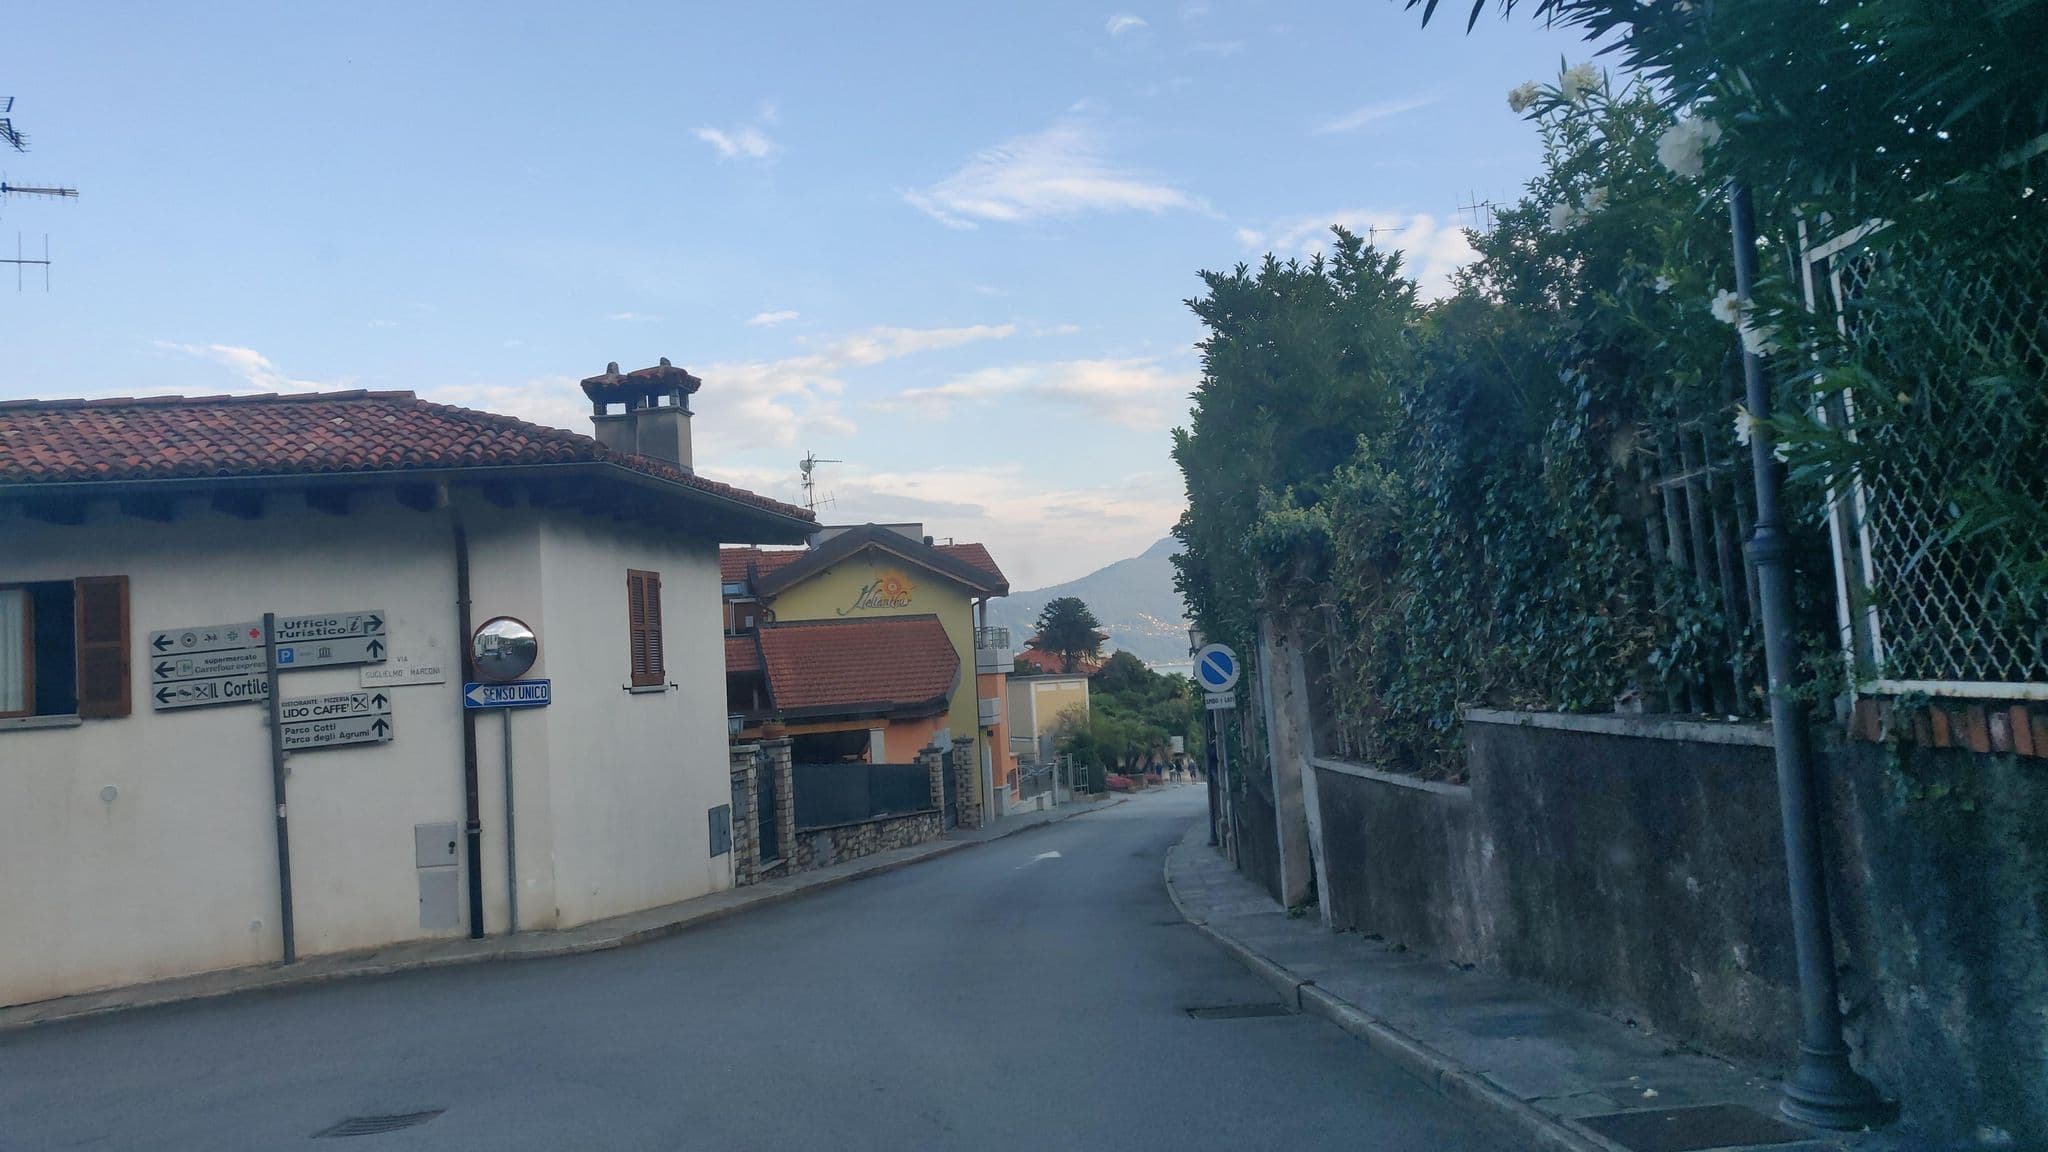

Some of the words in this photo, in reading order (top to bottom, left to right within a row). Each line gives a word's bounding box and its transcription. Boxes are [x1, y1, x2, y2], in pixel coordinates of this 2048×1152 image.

[284, 618, 338, 630] Ufficio
[277, 627, 346, 639] Turistico
[204, 654, 257, 665] supermercato
[195, 664, 235, 674] Carrefour
[365, 669, 403, 679] GUGLIELMO
[410, 666, 441, 676] MARCONI
[210, 683, 219, 699] Il
[224, 678, 268, 697] Cortile
[483, 686, 515, 701] SENSO
[518, 684, 547, 699] UNICO
[281, 699, 318, 707] RISTORANTE
[324, 696, 350, 704] PIZZERIA
[283, 708, 309, 719] LIDO
[313, 703, 349, 715] CAFFE'
[285, 726, 310, 735] Parco
[313, 723, 336, 732] Cotti
[285, 735, 310, 744] Parco
[314, 733, 335, 743] degli
[339, 729, 369, 740] Agrumi
